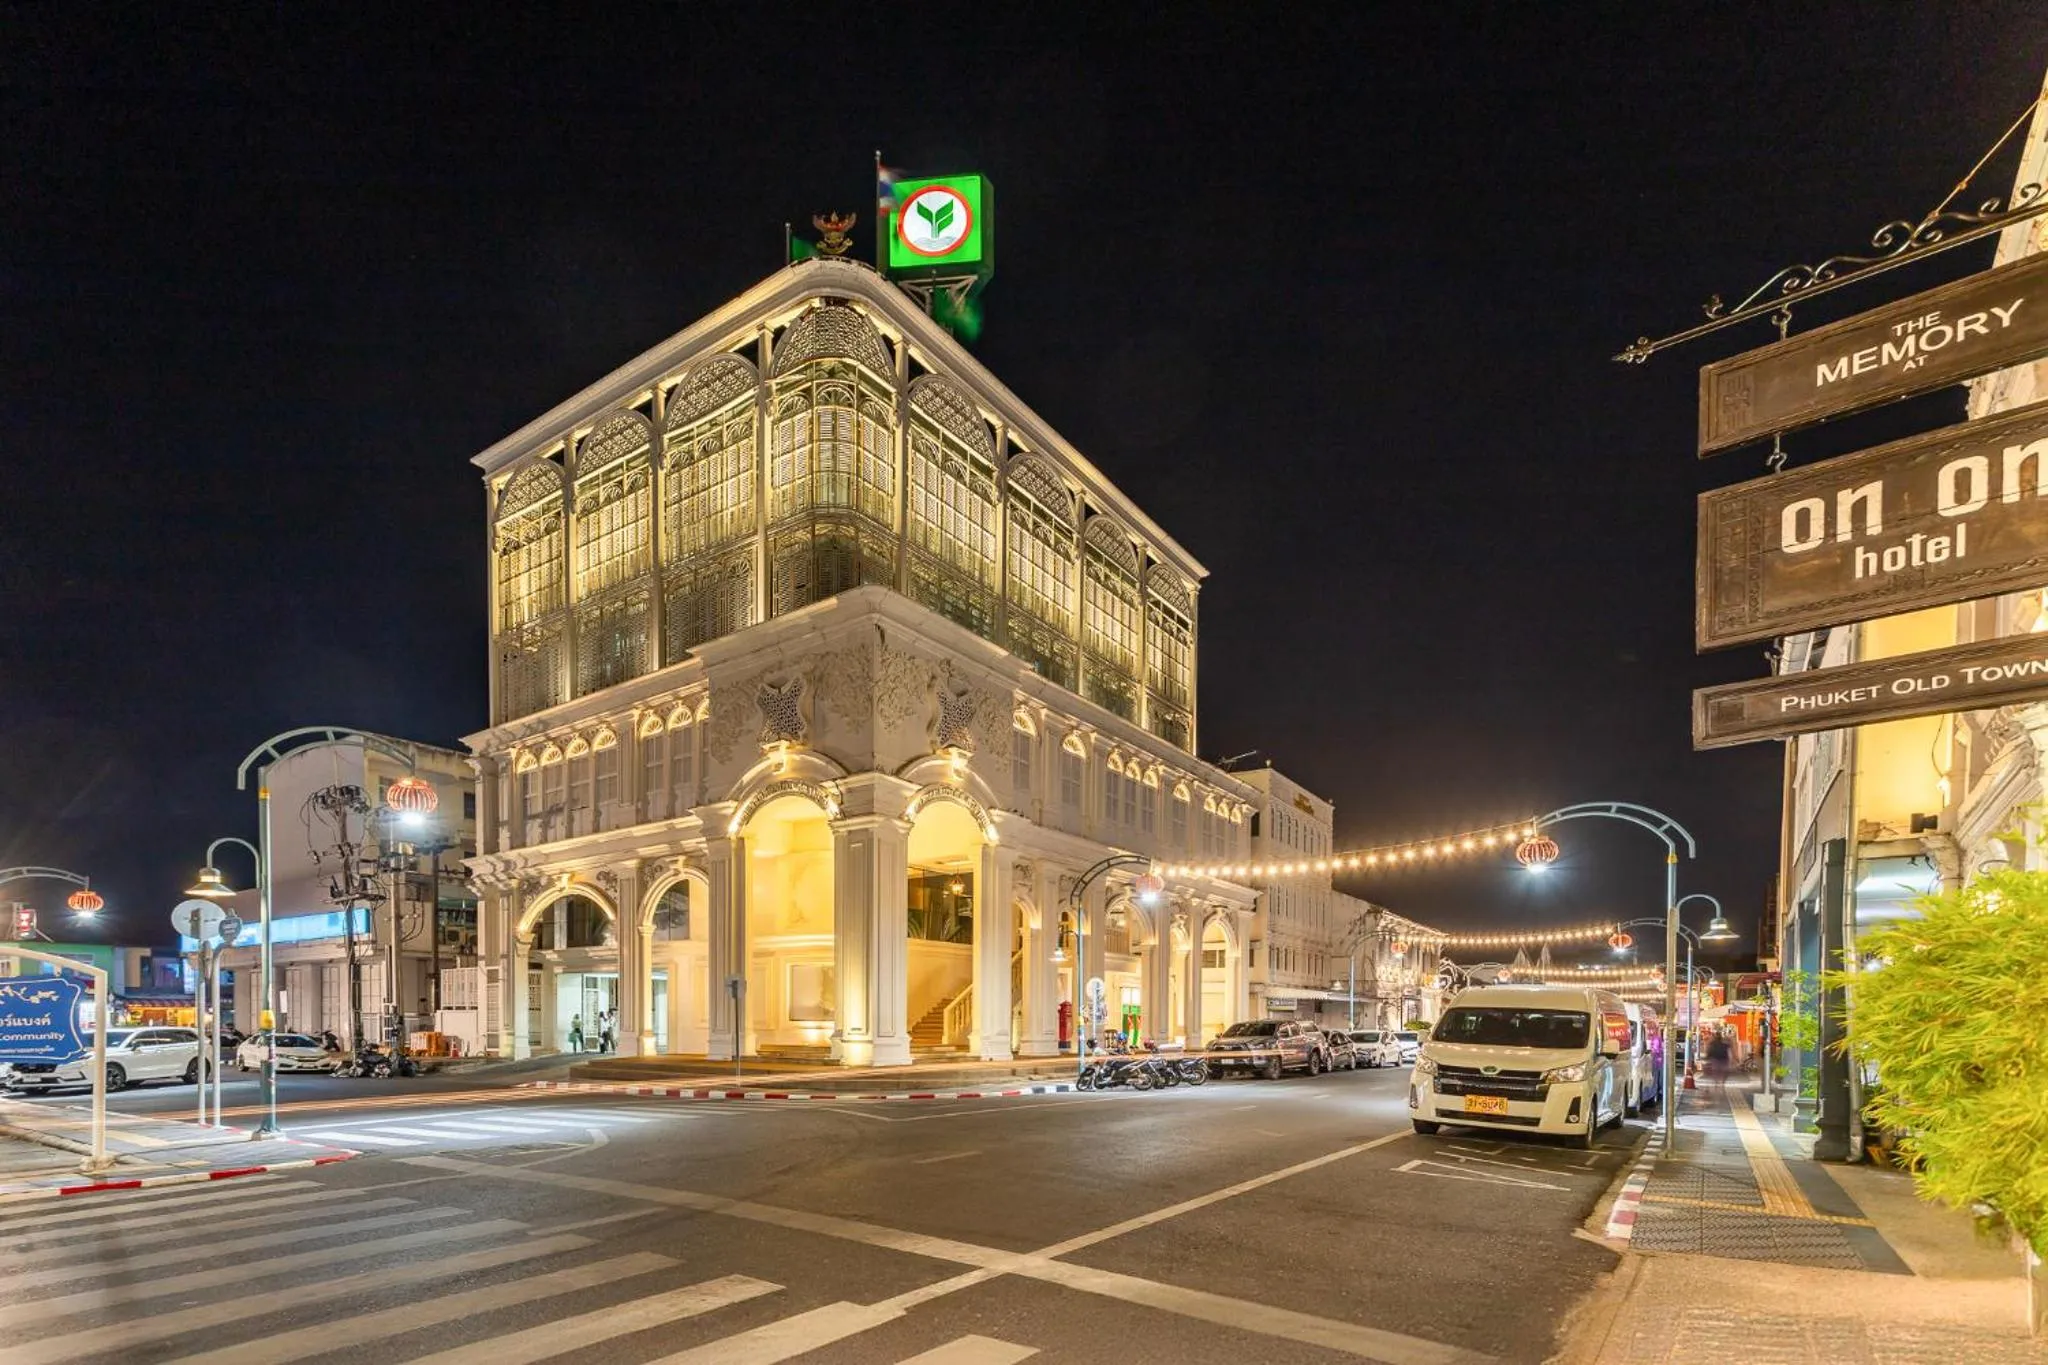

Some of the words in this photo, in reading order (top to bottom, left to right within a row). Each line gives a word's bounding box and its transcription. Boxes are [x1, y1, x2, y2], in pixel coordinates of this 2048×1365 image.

[1816, 299, 2024, 387] MEMORY
[1892, 311, 1941, 337] THE
[1903, 355, 1928, 372] AT
[1781, 480, 1883, 554] on
[1938, 438, 2048, 517] on
[1855, 523, 1966, 580] hotel
